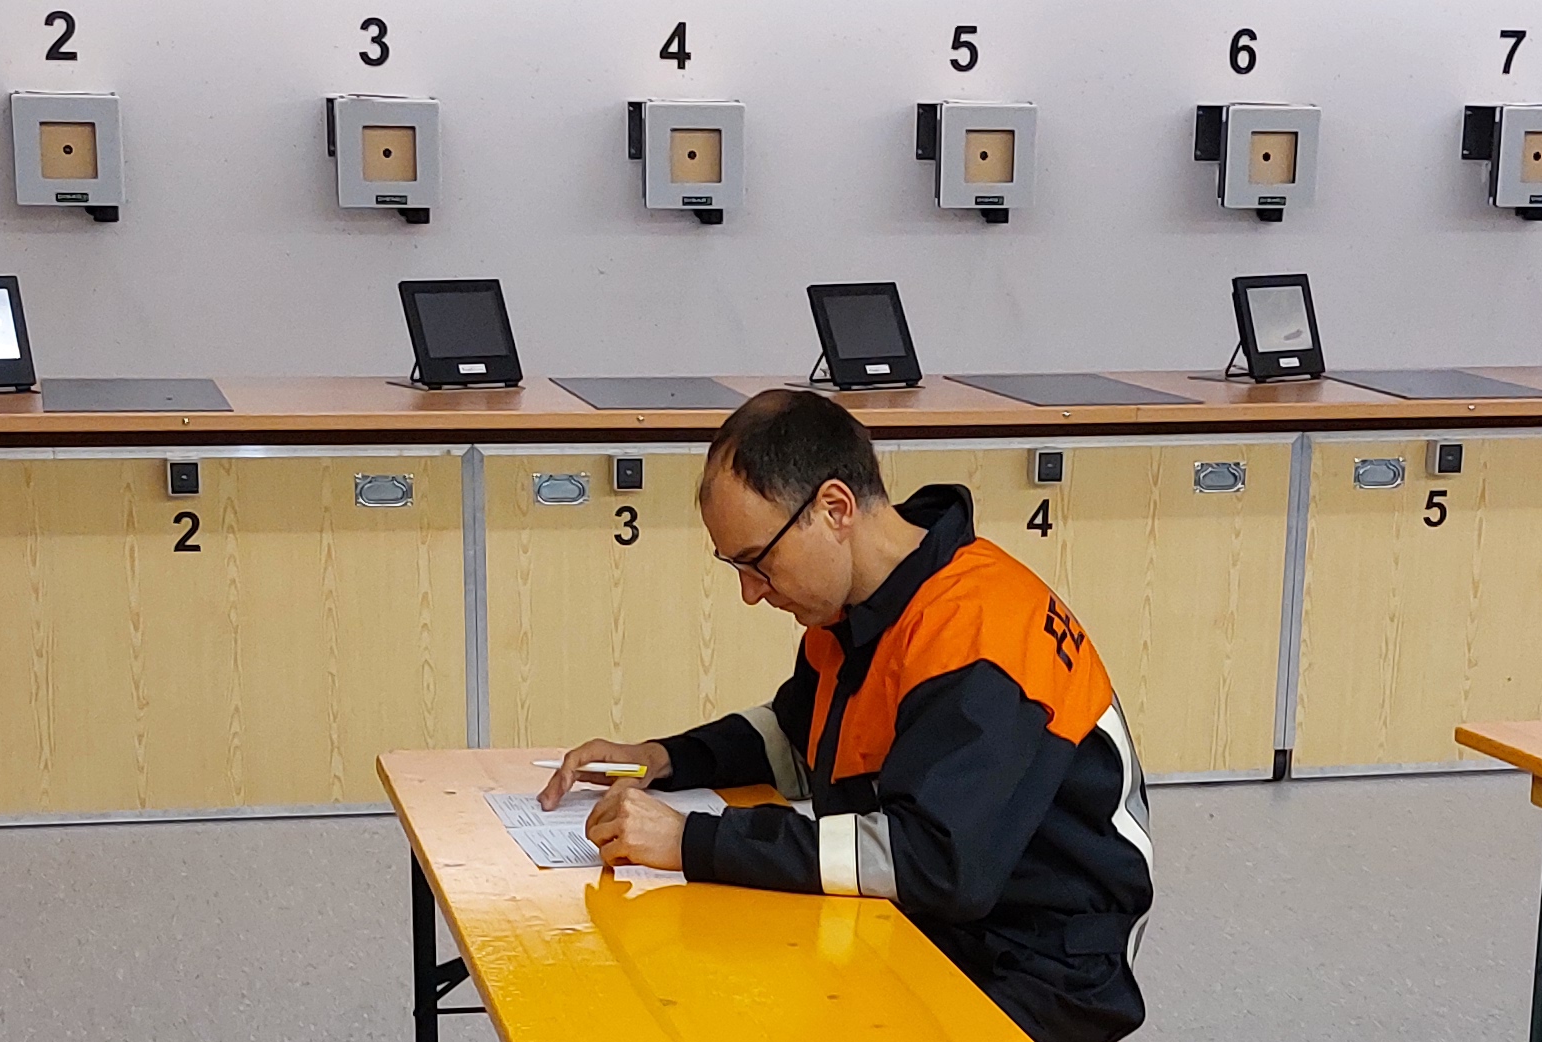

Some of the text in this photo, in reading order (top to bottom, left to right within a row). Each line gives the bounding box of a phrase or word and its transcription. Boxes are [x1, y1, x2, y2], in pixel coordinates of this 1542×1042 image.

[44, 10, 78, 61] 2
[358, 17, 390, 67] 3
[659, 21, 692, 70] 4
[949, 25, 979, 73] 5
[1229, 28, 1258, 75] 6
[1499, 29, 1527, 75] 7
[613, 505, 640, 546] 3
[1026, 498, 1053, 538] 4
[1423, 489, 1448, 528] 5
[172, 511, 201, 553] 2
